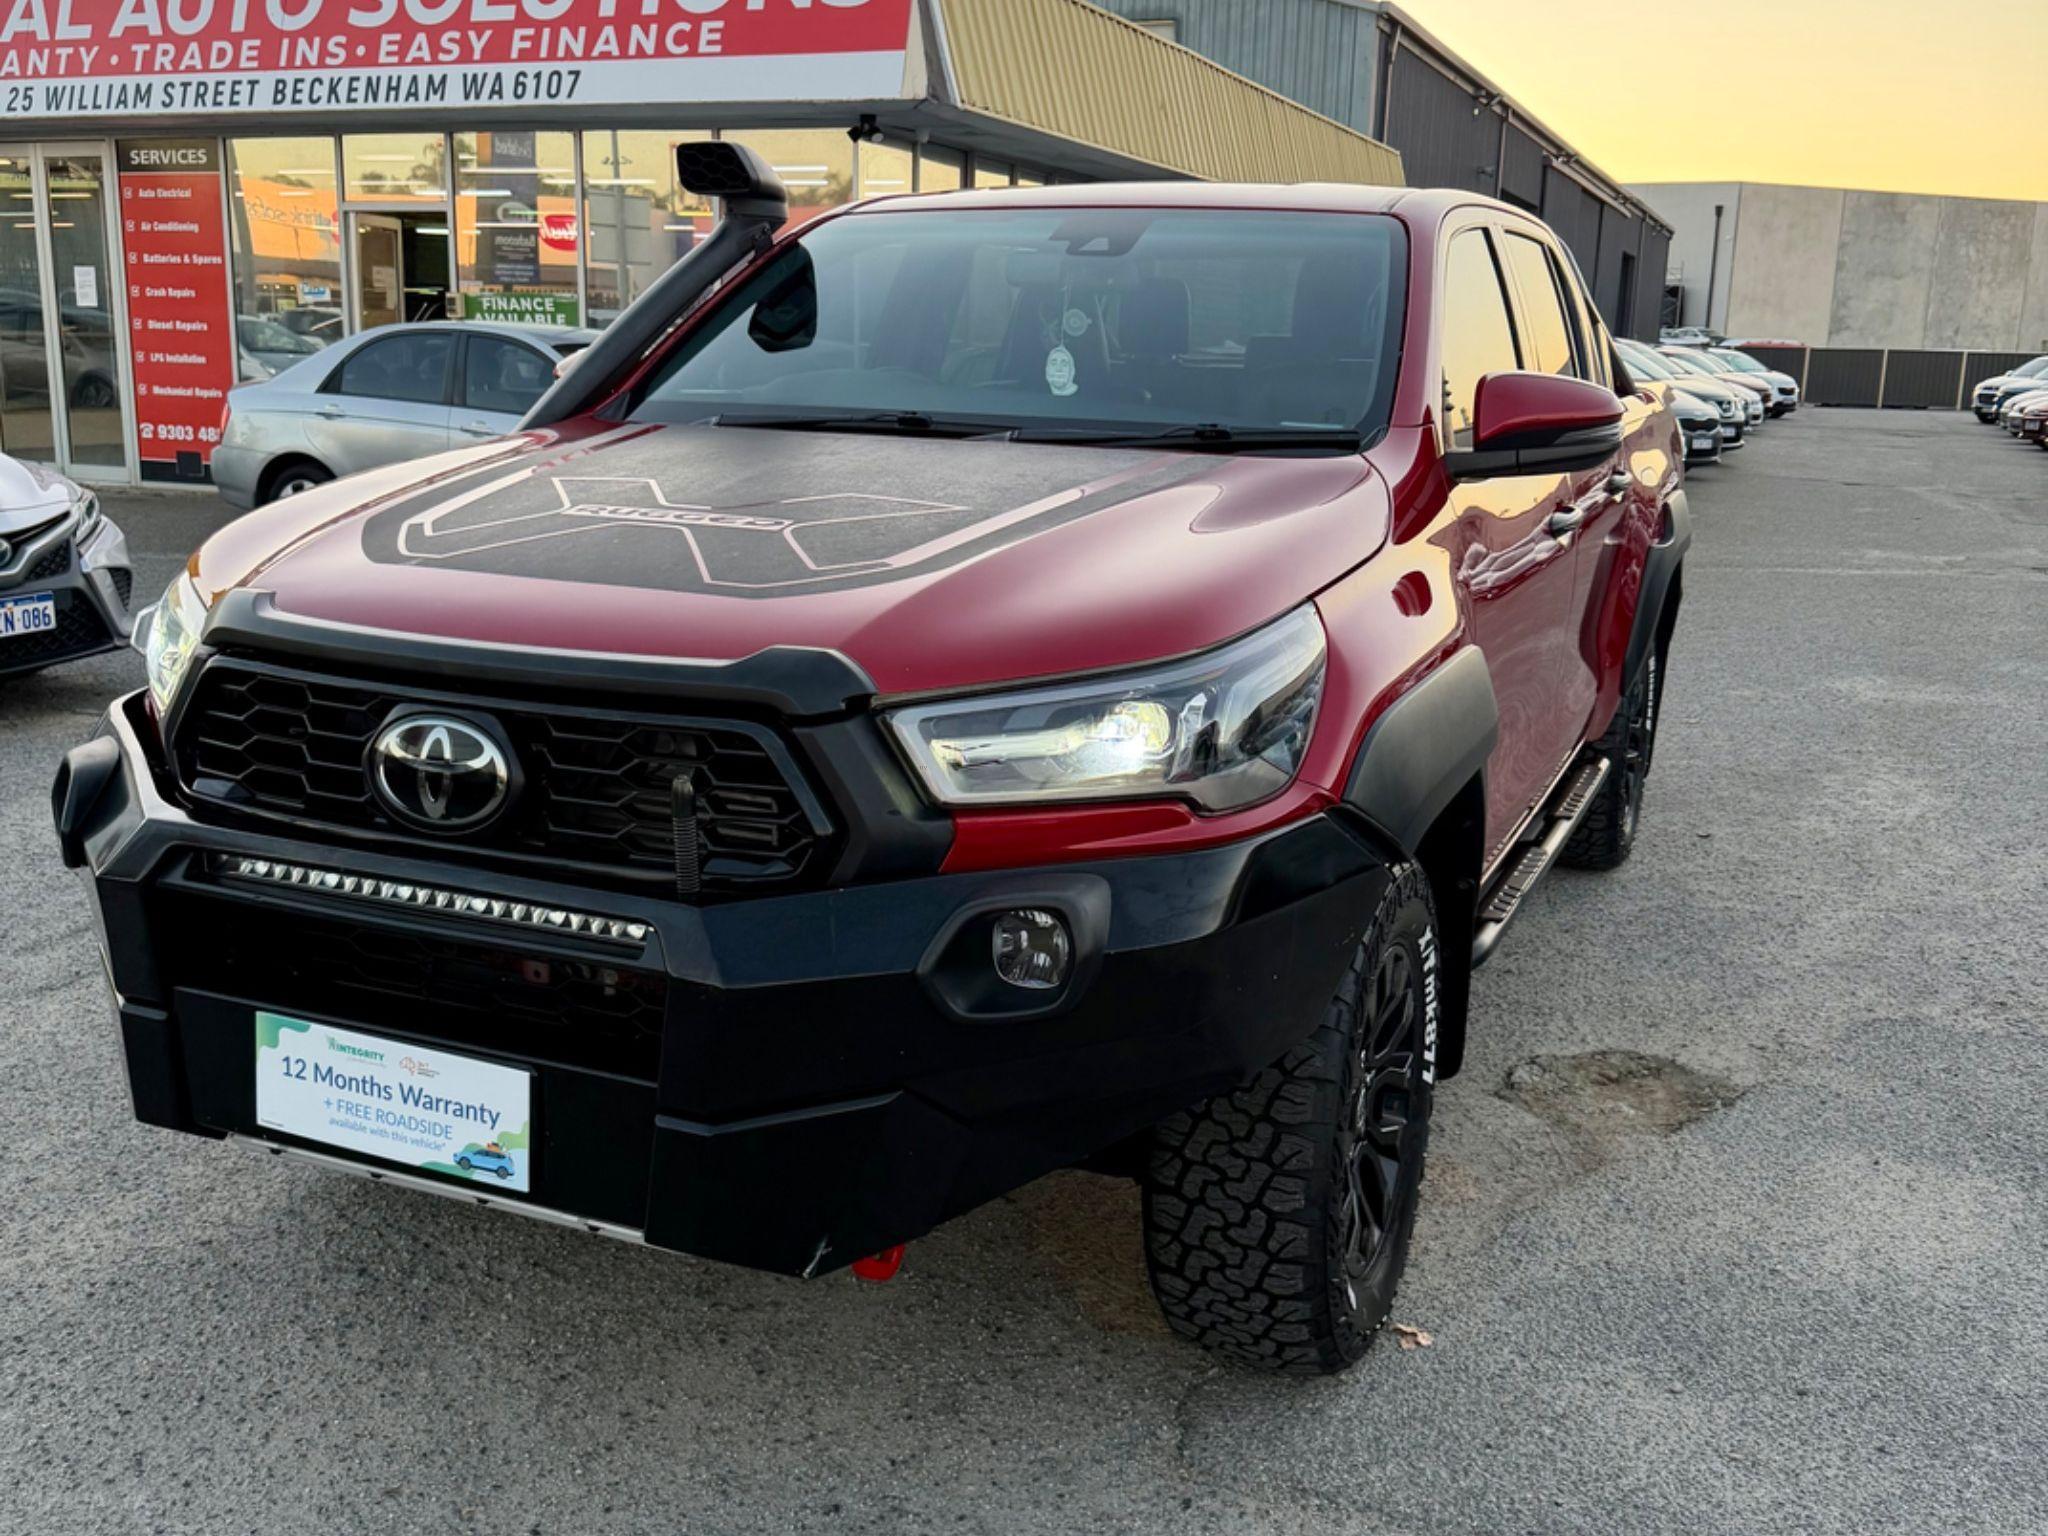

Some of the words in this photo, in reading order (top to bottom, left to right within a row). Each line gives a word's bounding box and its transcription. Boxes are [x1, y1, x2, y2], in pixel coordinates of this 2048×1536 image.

[0, 46, 99, 77] ANTY
[130, 39, 261, 72] TRADE
[279, 35, 348, 67] INS
[377, 30, 492, 64] EASY
[510, 20, 725, 60] FINANCE
[7, 87, 35, 113] 25
[44, 82, 154, 111] WILLIAM
[161, 79, 261, 109] STREET
[272, 74, 449, 106] BECKENHAM
[462, 72, 503, 101] WA
[512, 70, 582, 99] 6107
[129, 149, 208, 165] SERVICES
[138, 188, 156, 198] Auto
[140, 221, 152, 231] Air
[153, 221, 199, 233] Conditioning
[143, 253, 181, 264] Batteries
[192, 254, 223, 266] Spares
[168, 287, 196, 299] Repairs
[482, 297, 556, 312] FINANCE
[147, 320, 174, 331] Diesel
[175, 320, 209, 332] Repairs
[152, 386, 193, 396] Mechanical
[194, 387, 223, 398] Repairs
[157, 424, 195, 442] 9303
[22, 605, 52, 630] 086
[335, 1044, 385, 1062] INTEGRITY
[281, 1055, 307, 1081] 12
[313, 1062, 393, 1101] Months
[398, 1082, 501, 1130] Warranty
[322, 1097, 333, 1109] +
[336, 1098, 372, 1121] FREE
[375, 1107, 454, 1140] ROADSIDE
[328, 1117, 367, 1135] available
[369, 1126, 390, 1141] with
[391, 1130, 408, 1145] this
